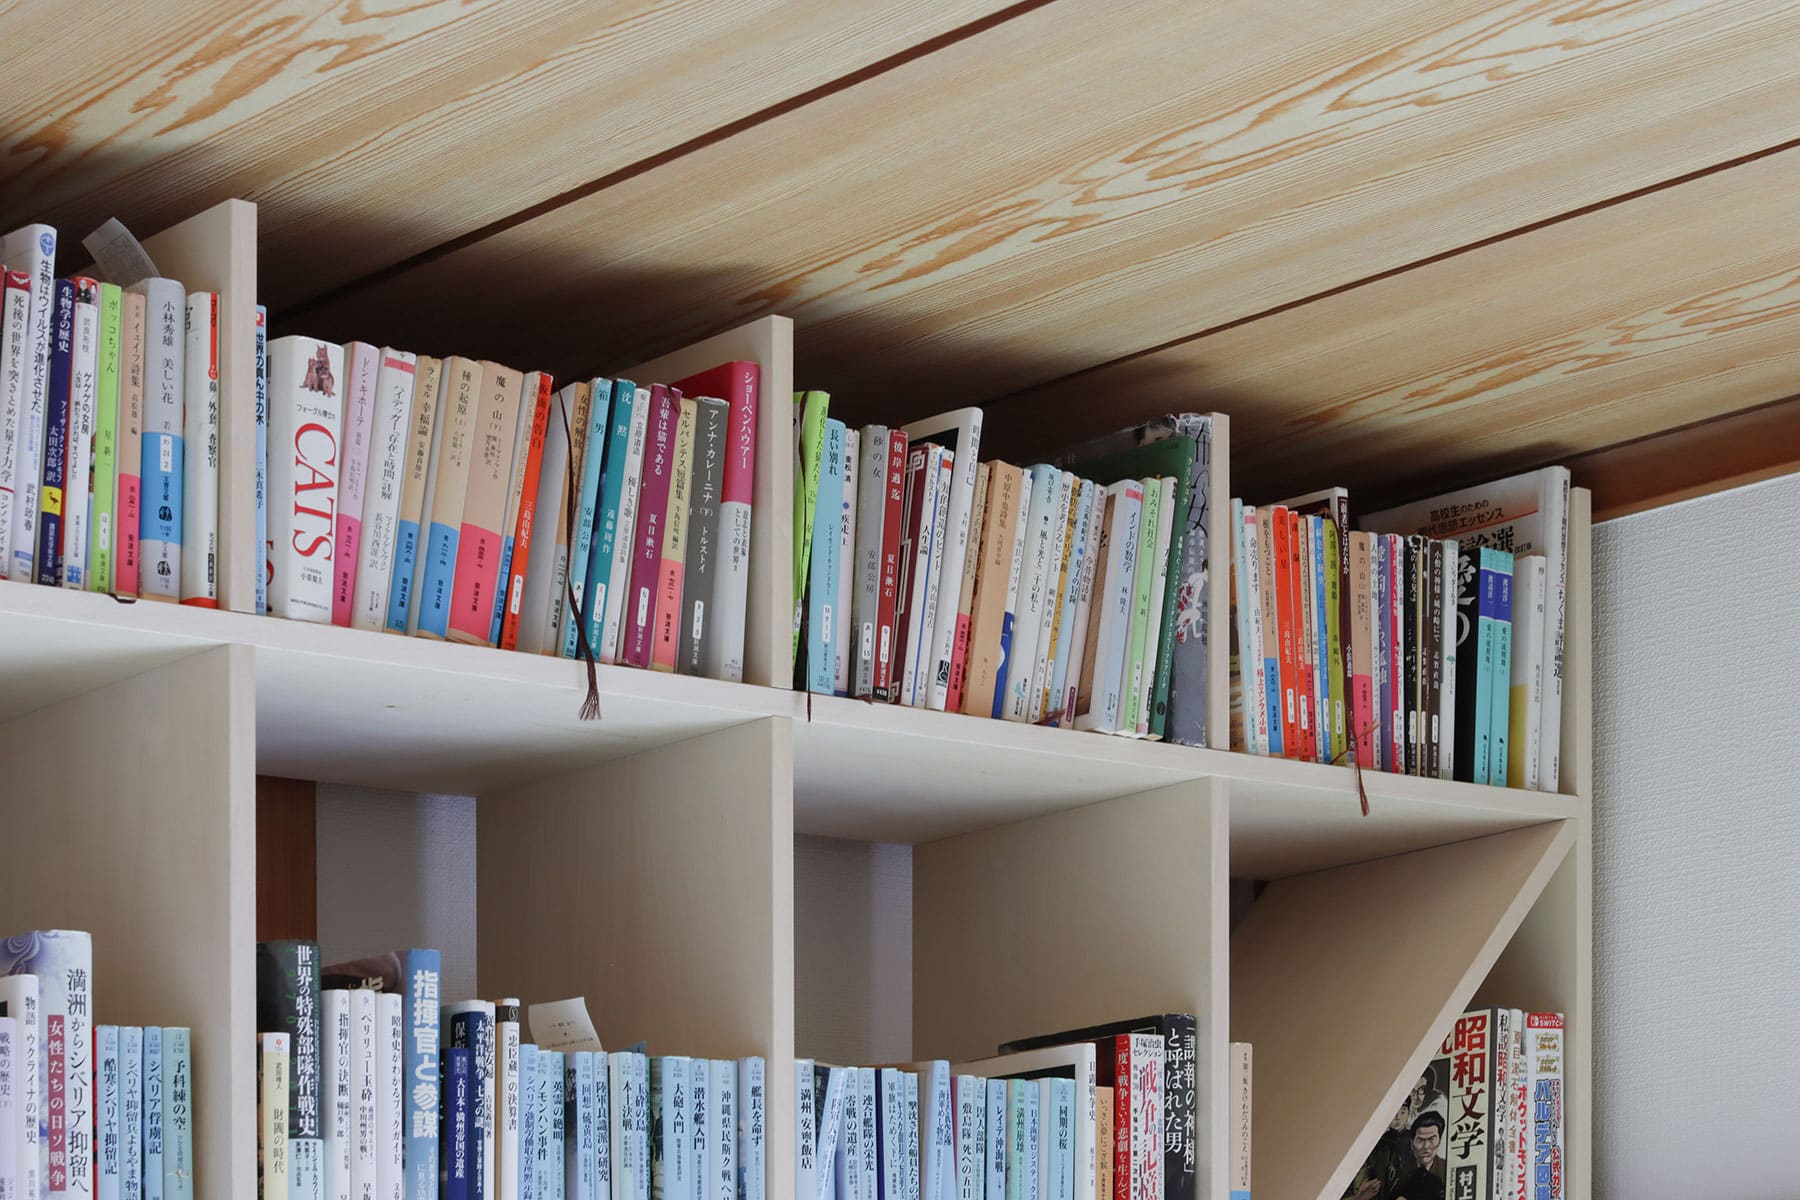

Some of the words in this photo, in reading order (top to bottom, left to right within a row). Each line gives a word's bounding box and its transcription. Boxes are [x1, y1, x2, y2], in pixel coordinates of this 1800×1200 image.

[31, 260, 52, 414] 生物はウイルスが進化させた
[58, 285, 73, 353] 生物学の歴史
[106, 300, 119, 374] ボッコちゃん
[162, 300, 176, 347] 小林秀雄
[81, 372, 92, 435] ゲゲゲの女房
[160, 357, 175, 405] 美しい花
[355, 357, 371, 428] ドン・キホーテ
[456, 369, 473, 417] 種の起原
[492, 374, 508, 422] 魔の山
[594, 389, 609, 435] 箱男
[417, 402, 432, 438] 幸福論
[616, 391, 632, 437] 沈黙
[653, 397, 671, 477] 吾輩は猫である
[739, 370, 755, 470] ショーペンハウアー
[701, 408, 720, 506] アンナ・カレーニナ
[827, 428, 840, 477] 長い別れ
[871, 434, 885, 480] 砂の女
[889, 439, 905, 502] 彼岸過迄
[966, 423, 983, 487] 時間と自己
[293, 422, 337, 561] CATS
[1429, 497, 1489, 524] 高校生のための
[644, 513, 658, 560] 夏目漱石
[698, 527, 710, 575] トルストイ
[840, 513, 851, 535] 疾走
[919, 523, 933, 556] 人生論
[1122, 512, 1137, 574] インドの数学
[1277, 514, 1288, 570] 美しい星
[884, 553, 897, 599] 夏目漱石
[1029, 528, 1050, 613] 風と光と二十の私と
[1078, 555, 1094, 603] 今昔物語集
[1248, 537, 1261, 593] 命売ります
[1358, 541, 1367, 581] 魔の山
[1370, 542, 1379, 601] 人間の土地
[25, 996, 37, 1026] 物語
[295, 944, 315, 1137] 世界の特殊部隊作戦史
[0, 1031, 11, 1097] 戦略の歴史
[338, 1012, 350, 1098] 指揮官の決断
[360, 1013, 373, 1101] ペリリュー玉砕
[412, 969, 439, 1140] 指揮官と参謀
[474, 1020, 486, 1080] 太平洋戦争
[1132, 1049, 1163, 1058] セレクション
[1133, 1037, 1163, 1050] 手塚治虫
[1496, 1014, 1510, 1124] 私説昭和文学
[25, 1033, 38, 1145] ウクライナの歴史
[48, 1020, 66, 1188] 女性たちの日ソ戦争
[66, 967, 89, 1194] 満洲からシベリア抑留へ
[172, 1060, 187, 1132] 予科練の空
[391, 1015, 402, 1165] 昭和史がわかるブックガイド
[507, 1028, 519, 1132] 「忠臣蔵」の決算書
[581, 1083, 592, 1109] 回想
[622, 1080, 634, 1132] 本土決戦
[635, 1082, 646, 1133] 玉砕の島
[672, 1082, 685, 1135] 大砲入門
[800, 1087, 812, 1115] 満州
[1088, 1060, 1097, 1122] 日露戦争史
[1164, 1027, 1183, 1154] と呼ばれた男
[1182, 1026, 1196, 1174] 「諜報の神様」
[1450, 1014, 1488, 1161] 昭和文学
[103, 1057, 118, 1176] 酷寒シベリヤ抑留記
[272, 1108, 285, 1175] 財閥の時代
[454, 1077, 466, 1179] 大日本・満州帝国の遺産
[537, 1079, 549, 1161] ノモンハン事件
[595, 1080, 609, 1182] 陸軍良識派の研究
[693, 1086, 706, 1151] 潜水艦入門
[750, 1084, 764, 1149] 艦長を命ず
[845, 1094, 858, 1157] 零戦の遺産
[862, 1094, 875, 1172] 連合艦隊の栄光
[887, 1081, 898, 1170] 軍旗はためく下に
[961, 1102, 973, 1140] 敷島隊
[994, 1106, 1005, 1173] レイテ沖海戦
[1058, 1104, 1069, 1151] 同期の桜
[1116, 1040, 1131, 1200] 二度と戦争という悲劇を生んで
[1138, 1060, 1159, 1200] 戦争の記憶
[1458, 1170, 1475, 1200] 村上
